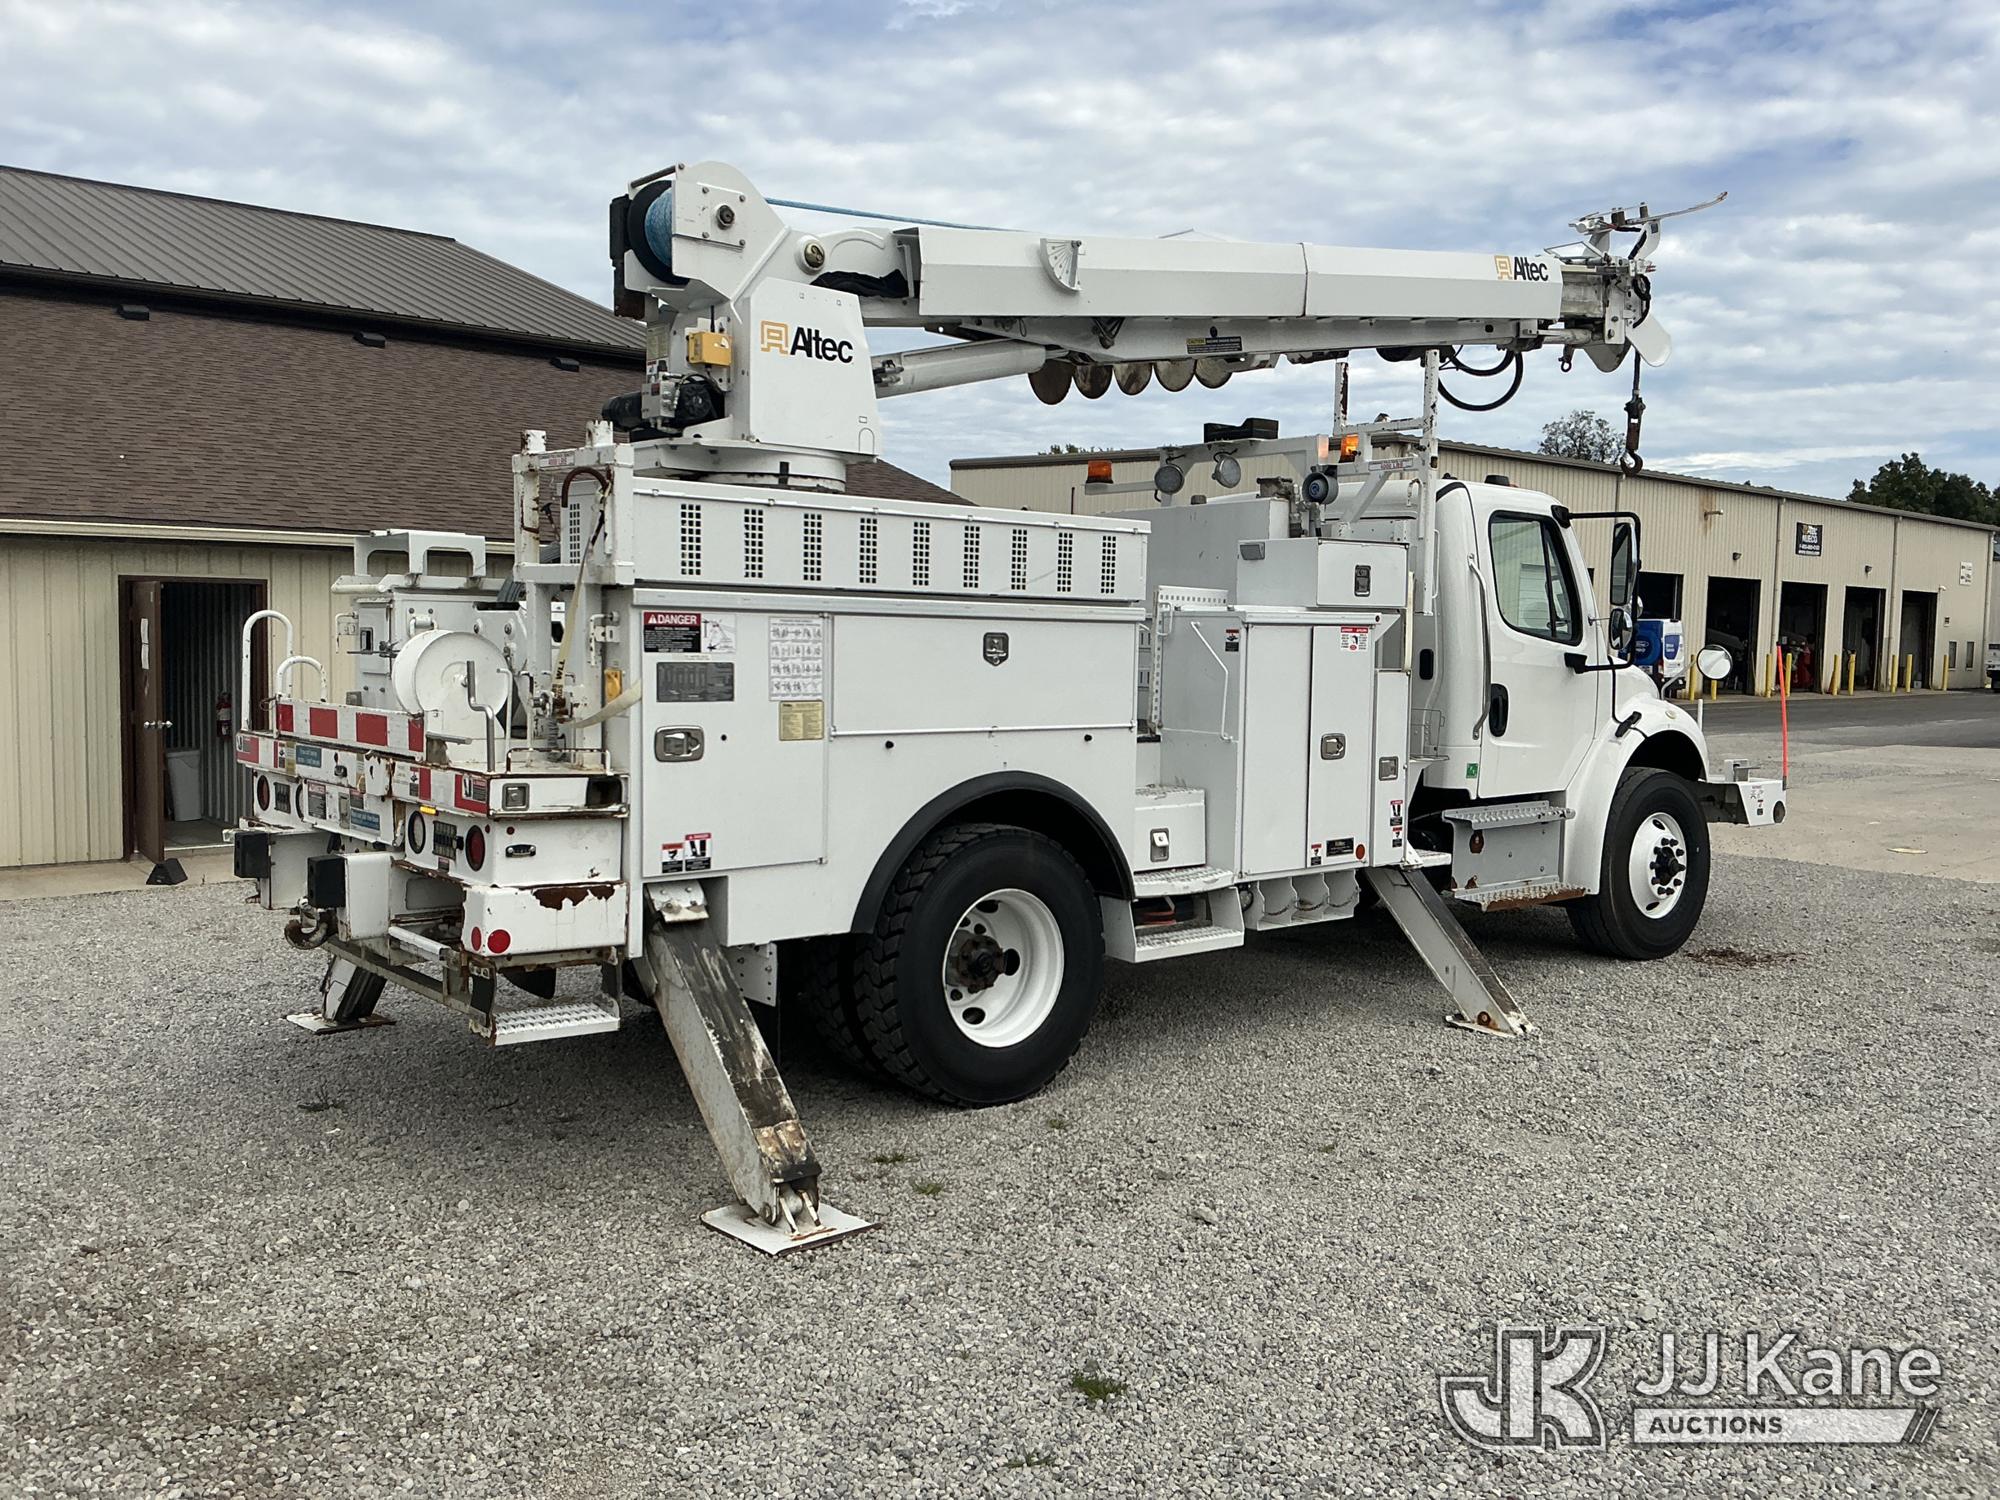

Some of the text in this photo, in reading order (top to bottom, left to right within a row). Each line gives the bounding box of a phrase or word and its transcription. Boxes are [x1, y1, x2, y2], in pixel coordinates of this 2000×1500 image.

[1513, 256, 1549, 281] Altec
[790, 326, 854, 364] Altec
[657, 614, 697, 625] DANGER
